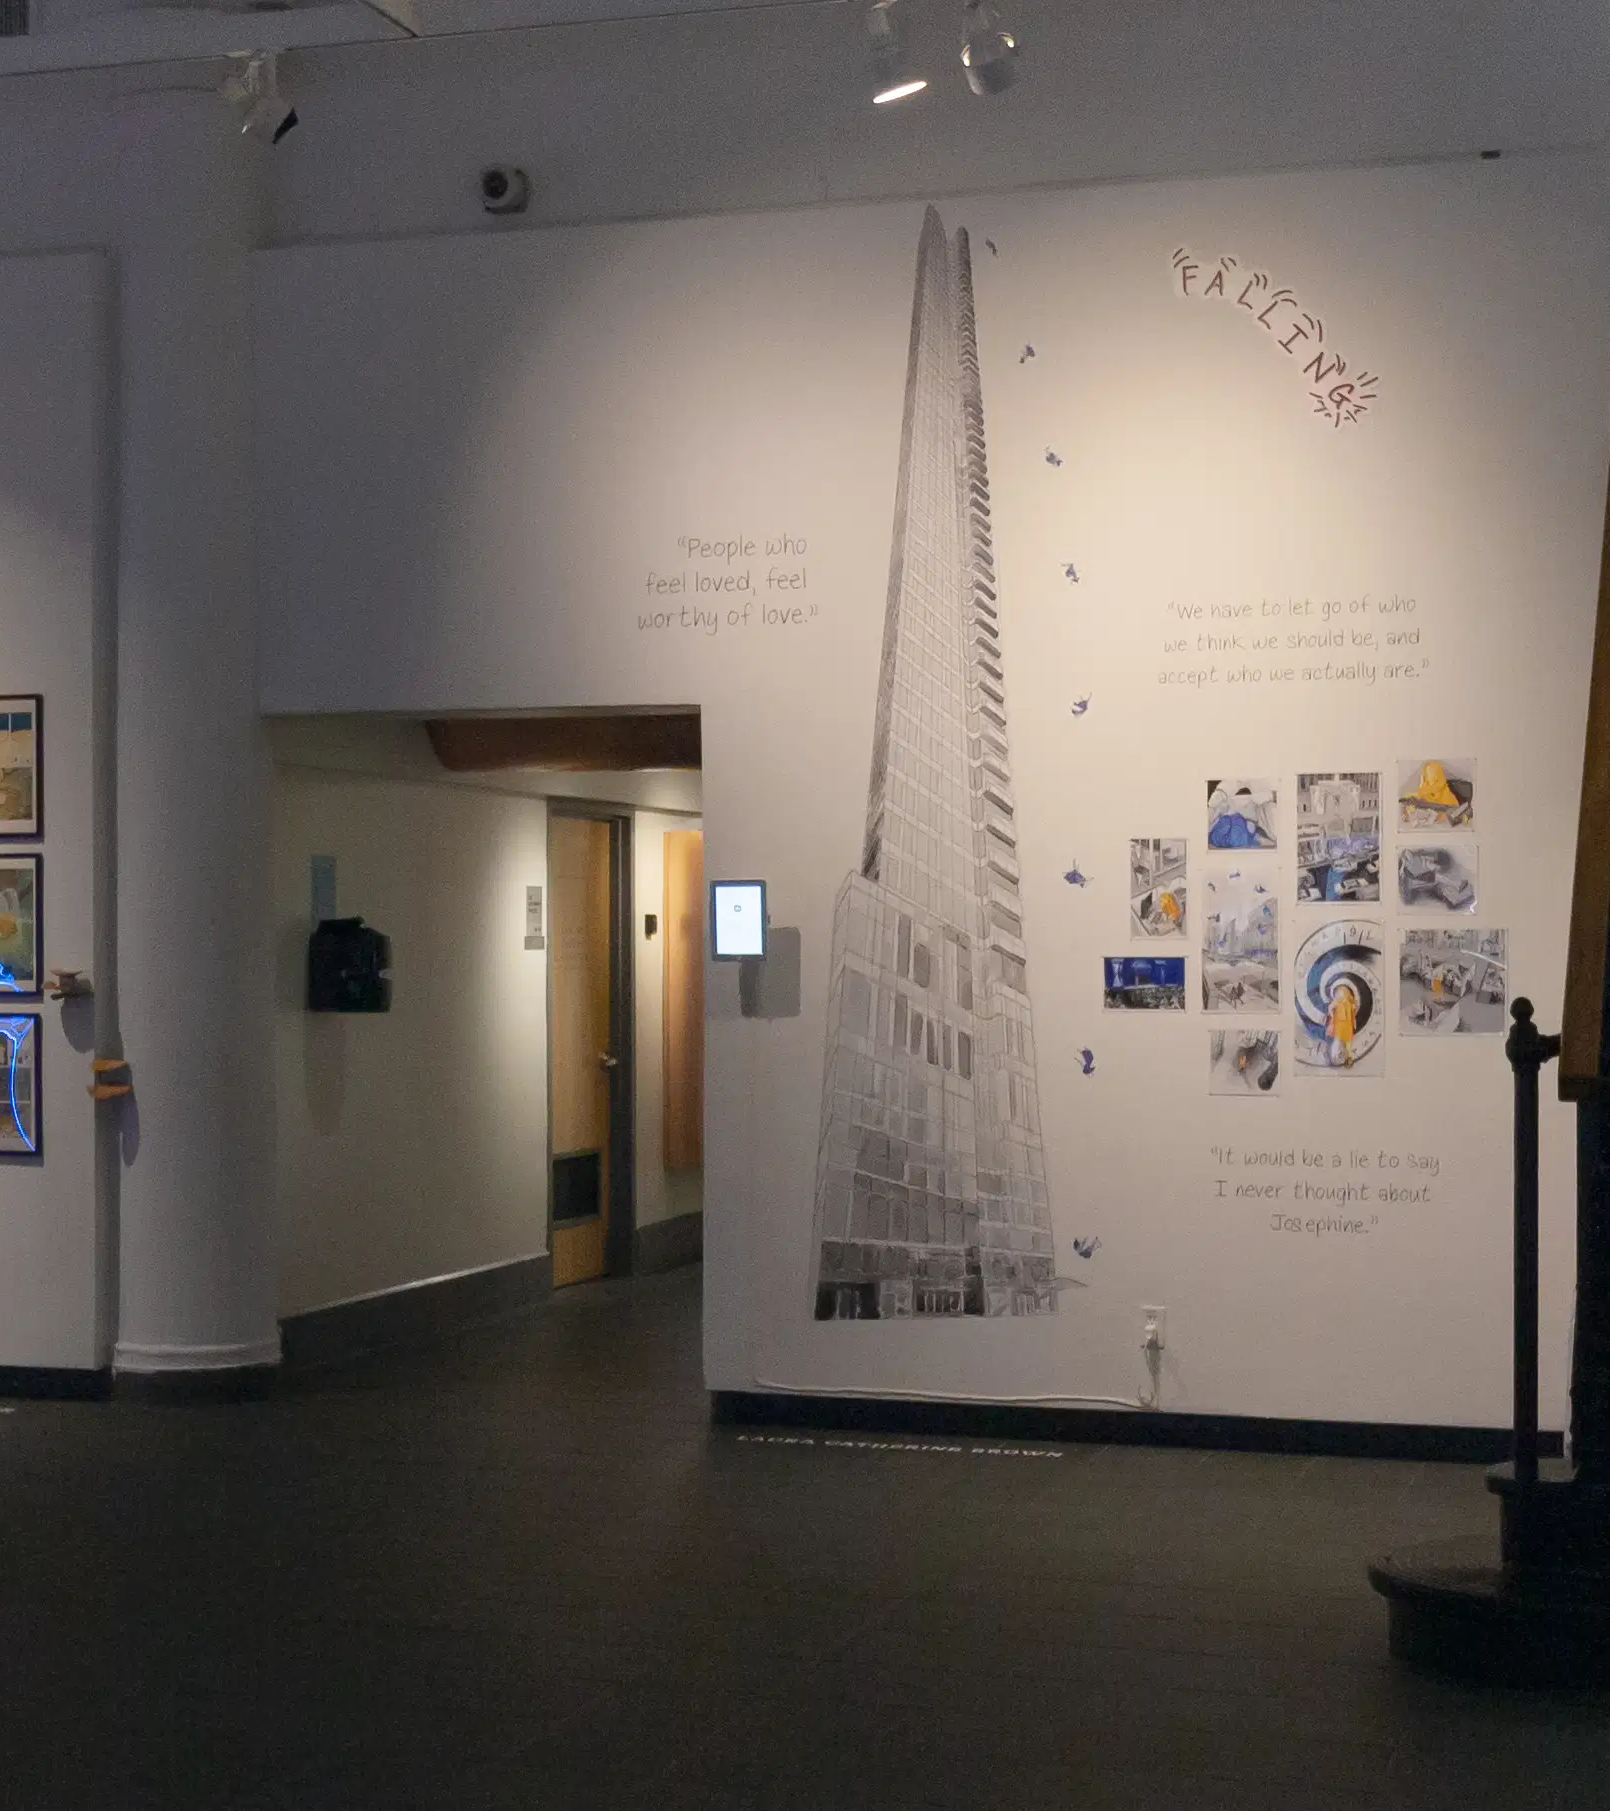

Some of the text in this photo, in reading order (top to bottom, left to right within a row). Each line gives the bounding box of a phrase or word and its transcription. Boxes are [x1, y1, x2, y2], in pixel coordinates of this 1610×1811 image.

[1179, 263, 1356, 410] FALLING
[765, 532, 807, 556] who
[645, 566, 807, 596] feel loved, feel
[638, 605, 718, 636] worthy
[727, 602, 753, 626] of
[1210, 598, 1253, 618] have
[1261, 599, 1281, 616] to
[1288, 597, 1314, 616] let
[1322, 600, 1341, 621] go
[1349, 594, 1370, 613] of
[1378, 594, 1416, 613] who
[1163, 628, 1420, 653] we think we should be, and
[1158, 665, 1218, 688] accept
[1226, 664, 1262, 683] who
[1269, 666, 1294, 682] we
[1301, 661, 1376, 686] actually
[1244, 1149, 1295, 1167] would
[1301, 1150, 1324, 1168] be
[1332, 1155, 1342, 1168] a
[1350, 1150, 1370, 1168] lie
[1377, 1150, 1400, 1168] to
[1406, 1153, 1441, 1176] say
[1214, 1180, 1431, 1207] I never thought about
